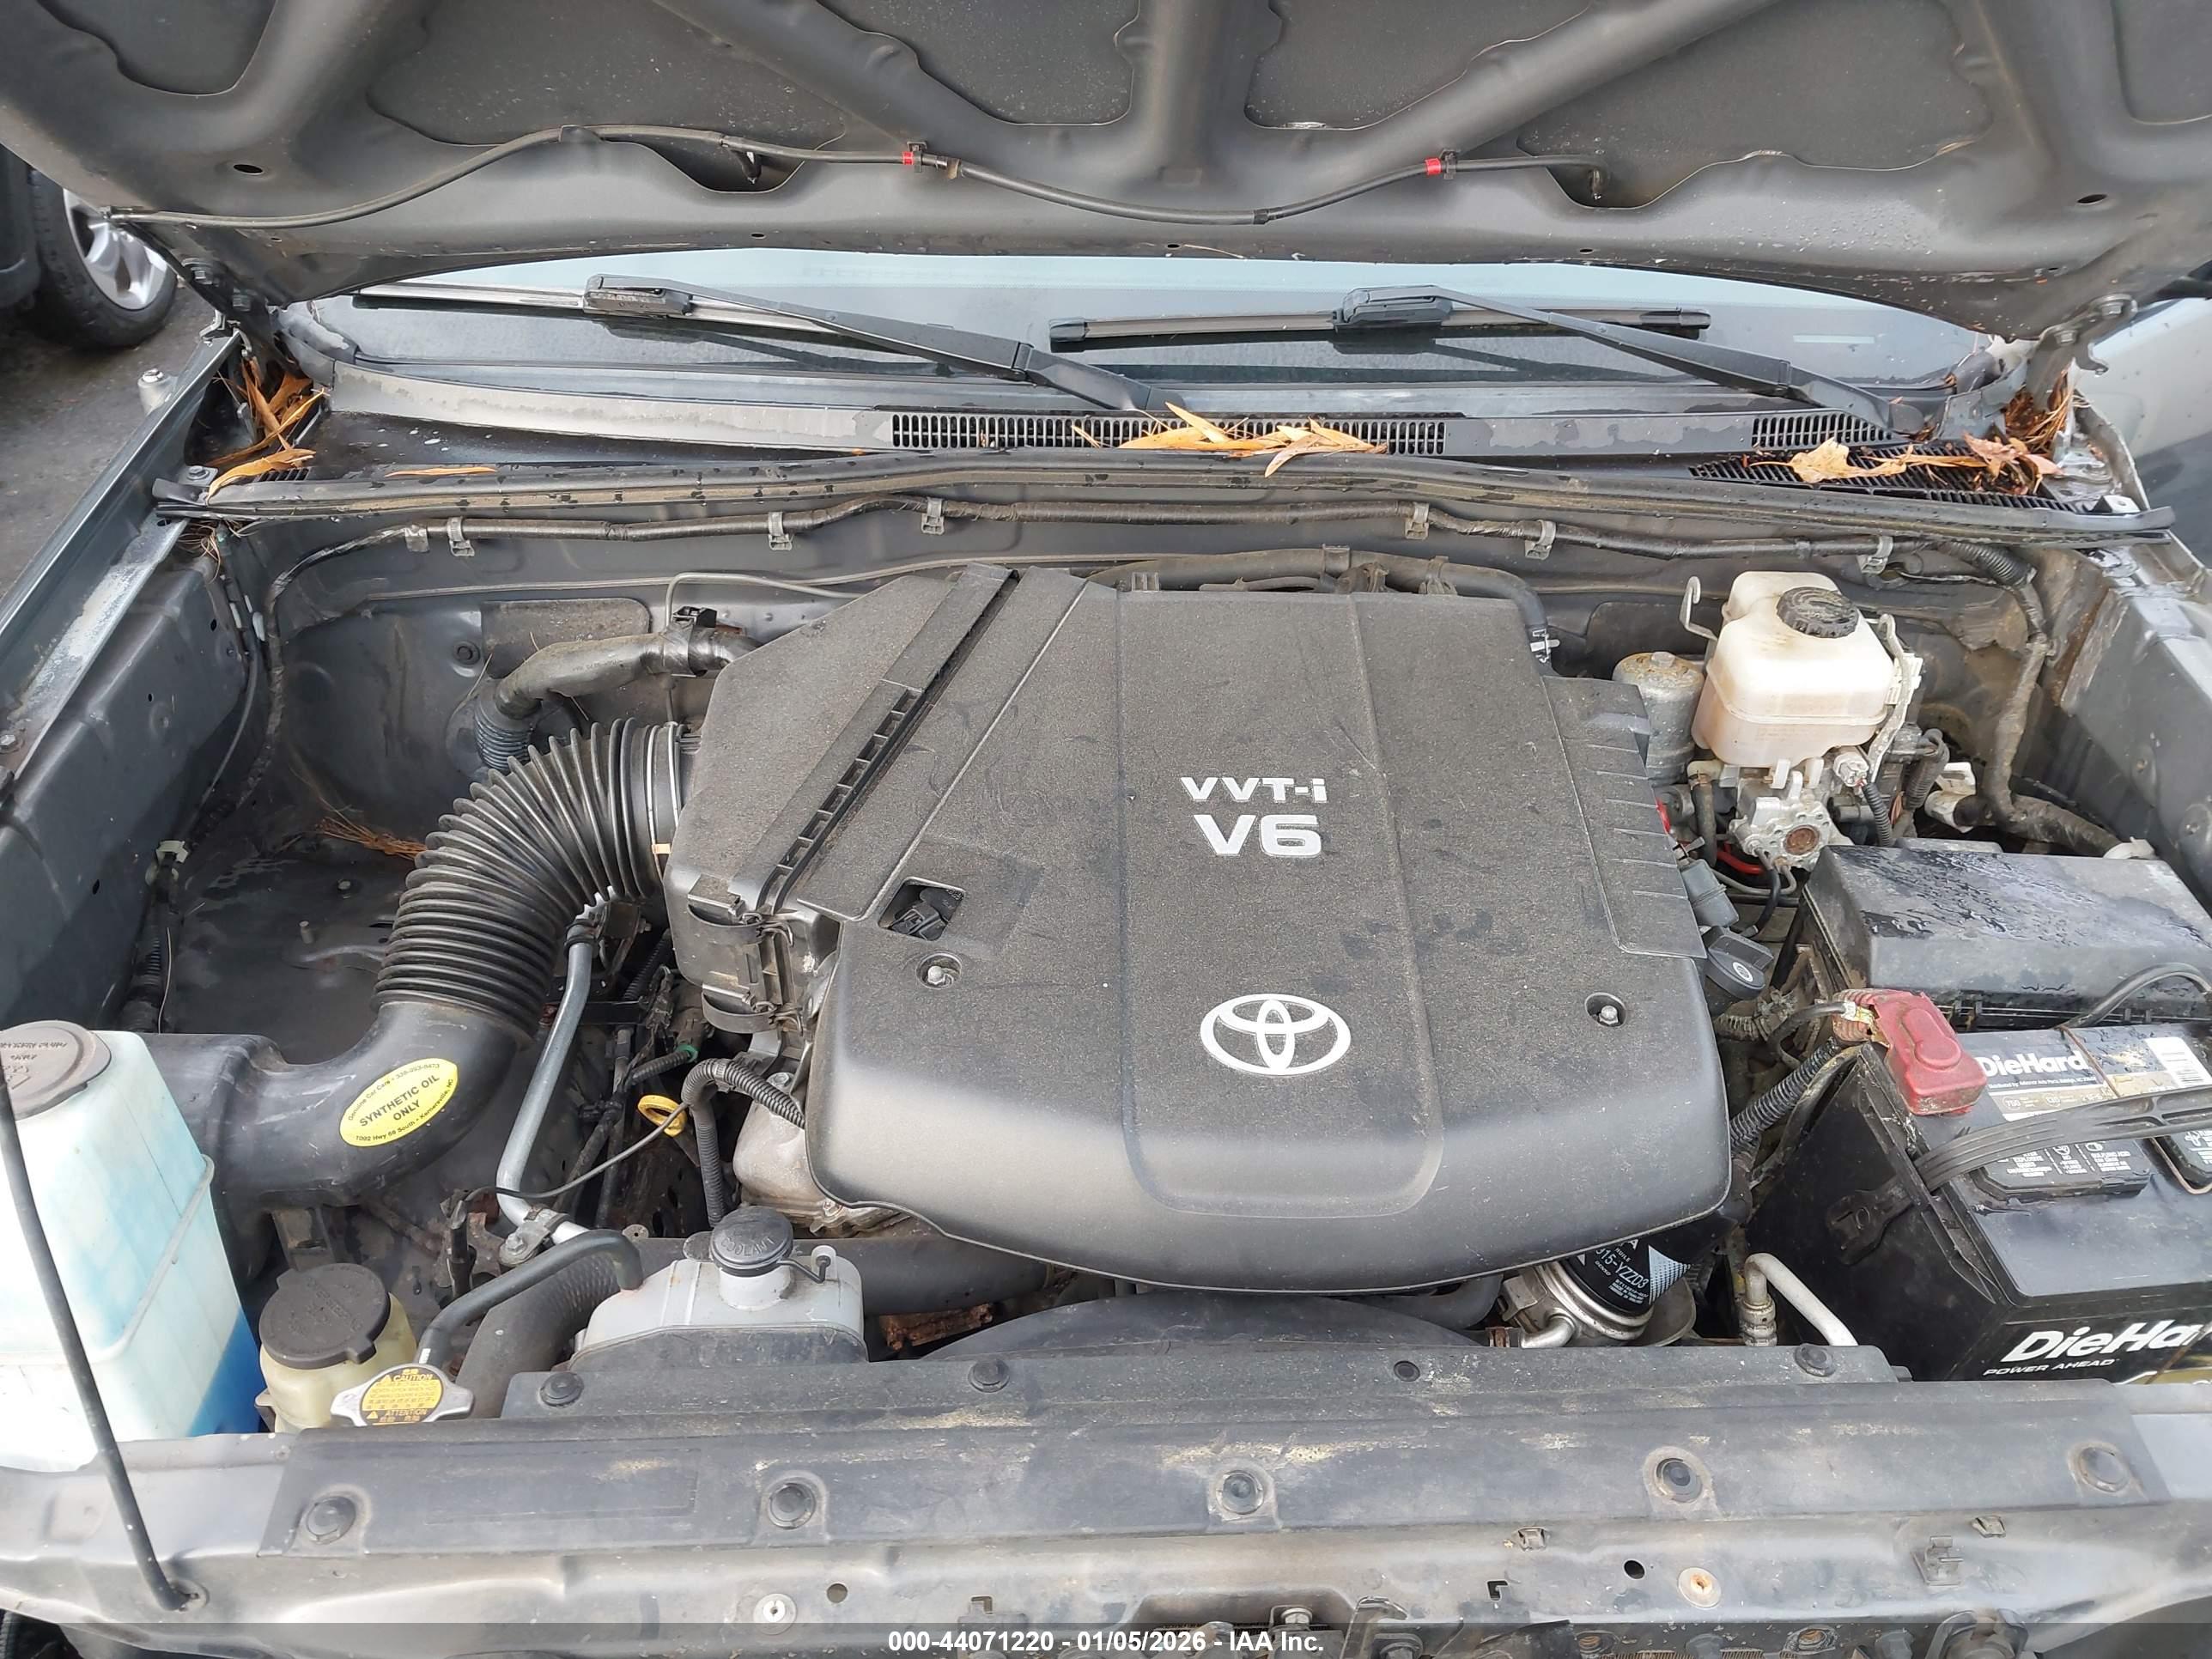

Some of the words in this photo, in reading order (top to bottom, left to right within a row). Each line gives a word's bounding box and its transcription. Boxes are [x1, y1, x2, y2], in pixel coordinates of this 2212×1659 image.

[1181, 776, 1328, 803] VVT-i
[1194, 814, 1322, 858] V6
[1975, 1050, 2089, 1077] DieHard
[359, 1086, 420, 1127] SYNTHETIC
[421, 1074, 440, 1089] OIL
[392, 1099, 421, 1121] ONLY
[397, 1121, 416, 1133] South
[721, 1237, 775, 1258] COOLANT
[1983, 1364, 2050, 1376] POWER
[2051, 1358, 2116, 1370] AHEAD
